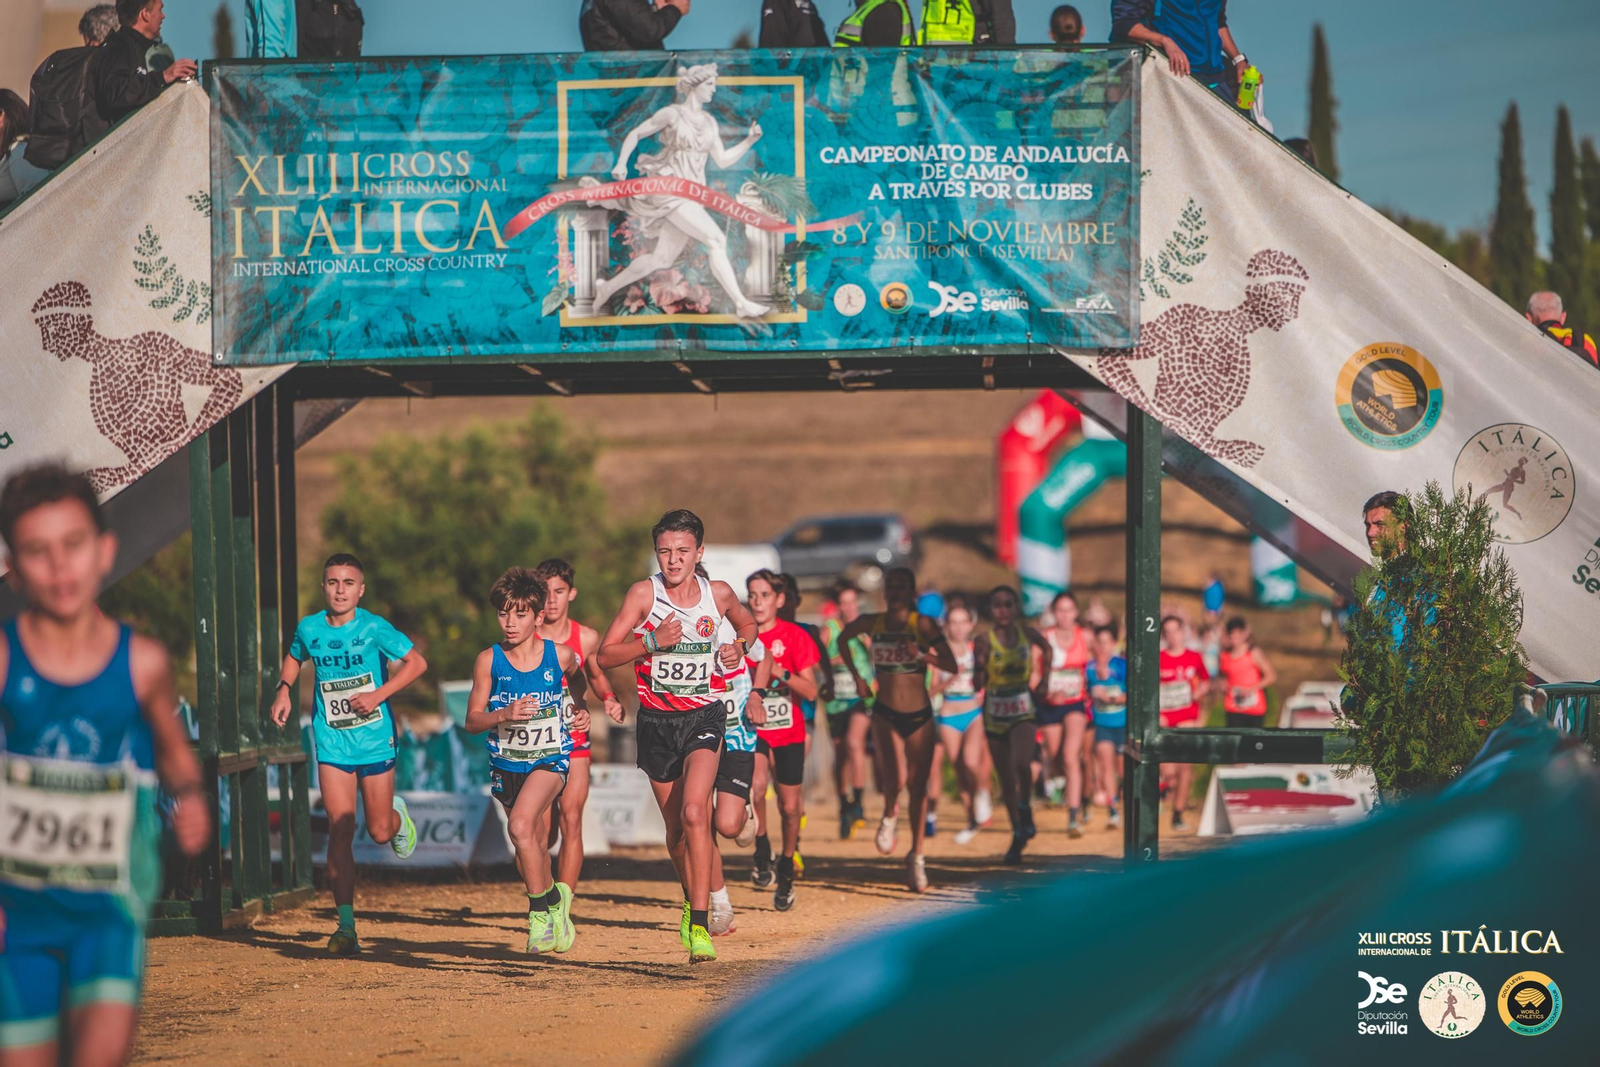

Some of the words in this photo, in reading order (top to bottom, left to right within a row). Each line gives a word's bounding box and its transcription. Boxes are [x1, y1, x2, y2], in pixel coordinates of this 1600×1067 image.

[820, 145, 966, 165] CAMPEONATO
[969, 146, 997, 163] DE
[1002, 142, 1130, 164] ANDALUCÍA
[234, 152, 362, 196] XLIII
[363, 151, 470, 178] CROSS
[921, 164, 946, 180] DE
[951, 163, 1028, 181] CAMPO
[363, 178, 509, 195] INTERNACIONAL
[868, 184, 885, 200] A
[889, 178, 966, 199] TRAVÉS
[969, 182, 1012, 200] POR
[1016, 183, 1093, 200] CLUBES
[528, 189, 575, 220] CROSS
[581, 179, 685, 200] INTERNACIONAL
[689, 183, 710, 201] DE
[231, 193, 510, 258] ITÁLICA
[832, 224, 847, 245] 8
[856, 222, 873, 244] Y
[881, 222, 897, 244] 9
[906, 222, 939, 244] DE
[947, 220, 1117, 245] NOVIEMBRE
[874, 245, 988, 261] SANTIPONCE
[992, 244, 1074, 262] (SEVILLA)
[233, 258, 370, 277] INTERNATIONAL
[375, 257, 425, 272] CROSS
[428, 253, 508, 271] COUNTRY
[981, 296, 1029, 312] Sevilla
[1356, 348, 1378, 364] GOLD
[1379, 346, 1406, 357] LEVEL
[1356, 400, 1398, 431] ATHLETICS
[1367, 397, 1396, 420] WORLD
[1347, 417, 1370, 440] WORLD
[1397, 422, 1430, 446] COUNTRY
[1428, 401, 1440, 422] TOUR
[1478, 426, 1567, 500] ITÁLICA
[200, 617, 208, 634] 1
[1145, 616, 1157, 632] 2
[312, 650, 364, 670] nerja
[657, 660, 709, 681] 5821
[504, 725, 557, 746] 7971
[7, 802, 114, 853] 7961
